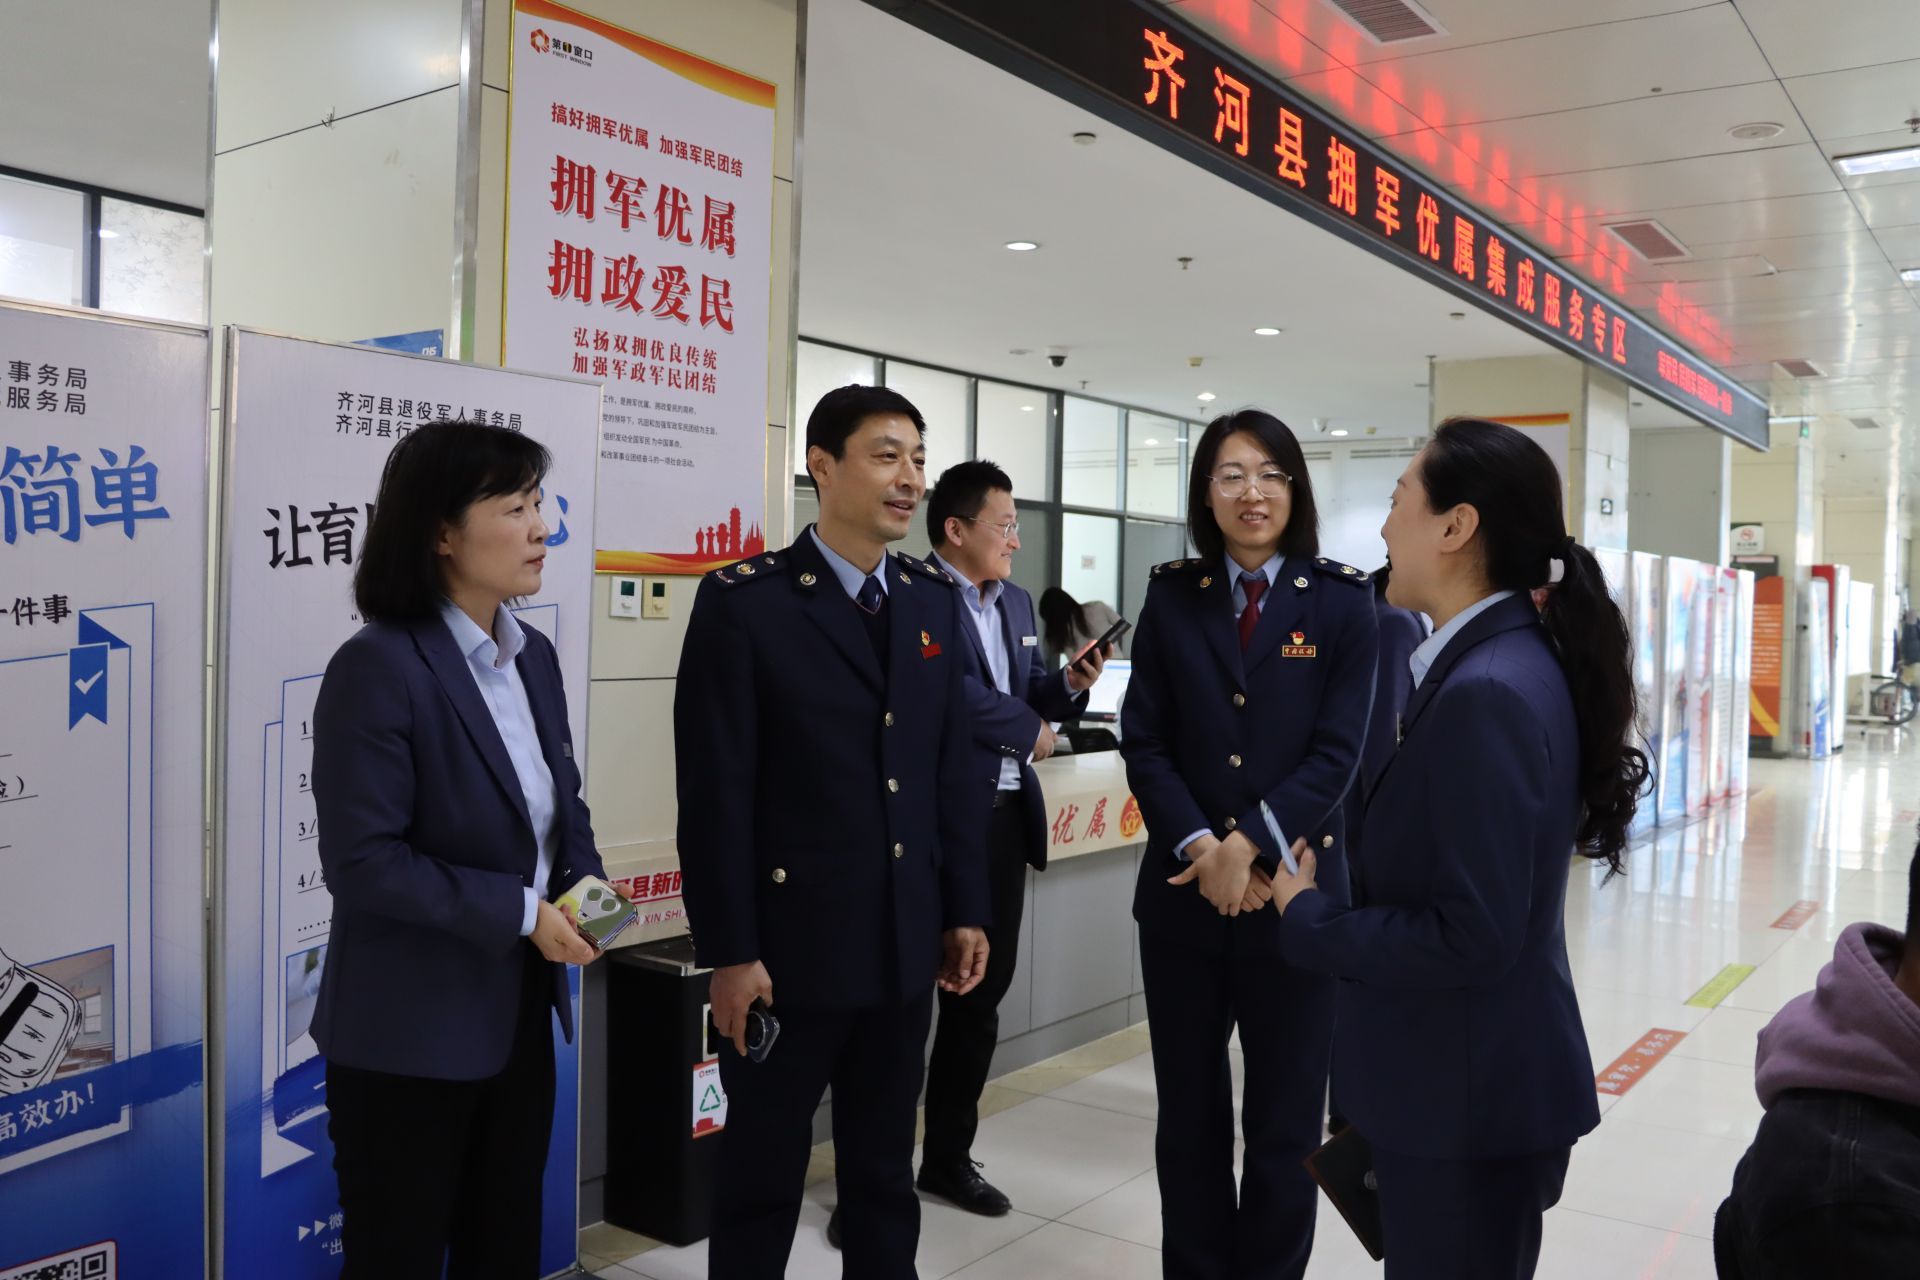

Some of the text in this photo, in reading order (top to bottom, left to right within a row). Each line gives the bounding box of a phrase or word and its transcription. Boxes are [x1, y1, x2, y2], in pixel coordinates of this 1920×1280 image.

[551, 102, 744, 177] 搞好拥军优属 加强军民团结
[549, 154, 736, 257] 拥军优属
[1144, 28, 1627, 365] 齐河县拥军优属集成服务专区
[547, 238, 735, 332] 拥政爱民
[572, 352, 718, 394] 加强军政军民团结
[573, 327, 718, 371] 弘扬双拥优良传统
[0, 360, 87, 389] 事务局
[0, 386, 86, 415] 服务局
[337, 391, 522, 433] 齐河县退役军人事务局
[336, 413, 424, 440] 齐河县行
[0, 445, 170, 546] 简单
[263, 502, 374, 568] 让育
[1052, 797, 1107, 846] 优属
